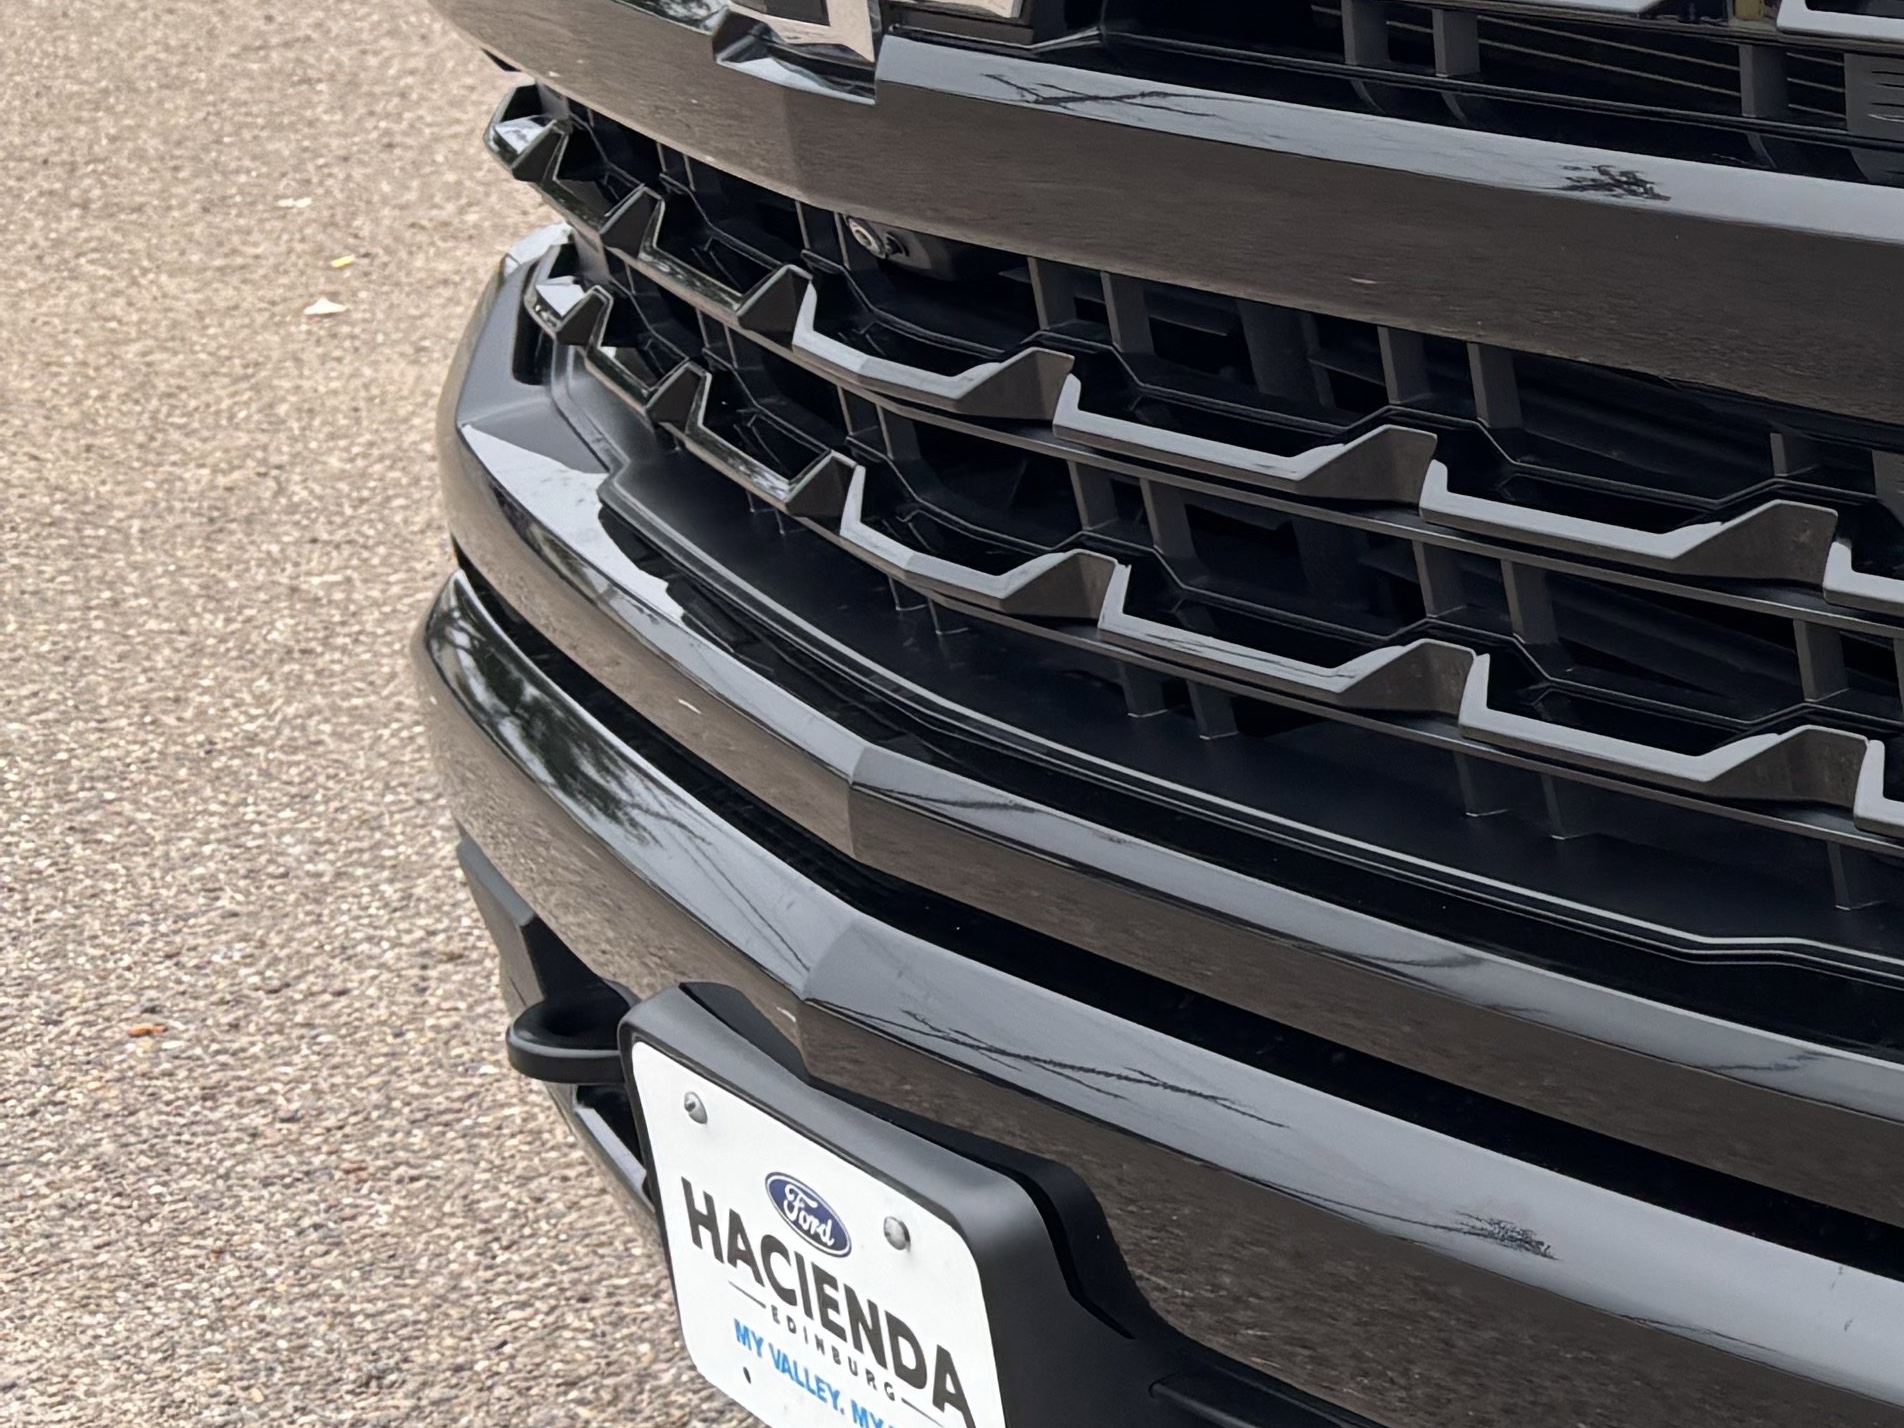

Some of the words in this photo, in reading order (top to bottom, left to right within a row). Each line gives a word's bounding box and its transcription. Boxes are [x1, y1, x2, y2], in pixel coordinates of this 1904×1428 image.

[783, 1183, 835, 1247] Ford
[734, 1318, 764, 1359] MY
[770, 1342, 845, 1416] VALLEY.
[771, 1305, 896, 1402] EDINBURG
